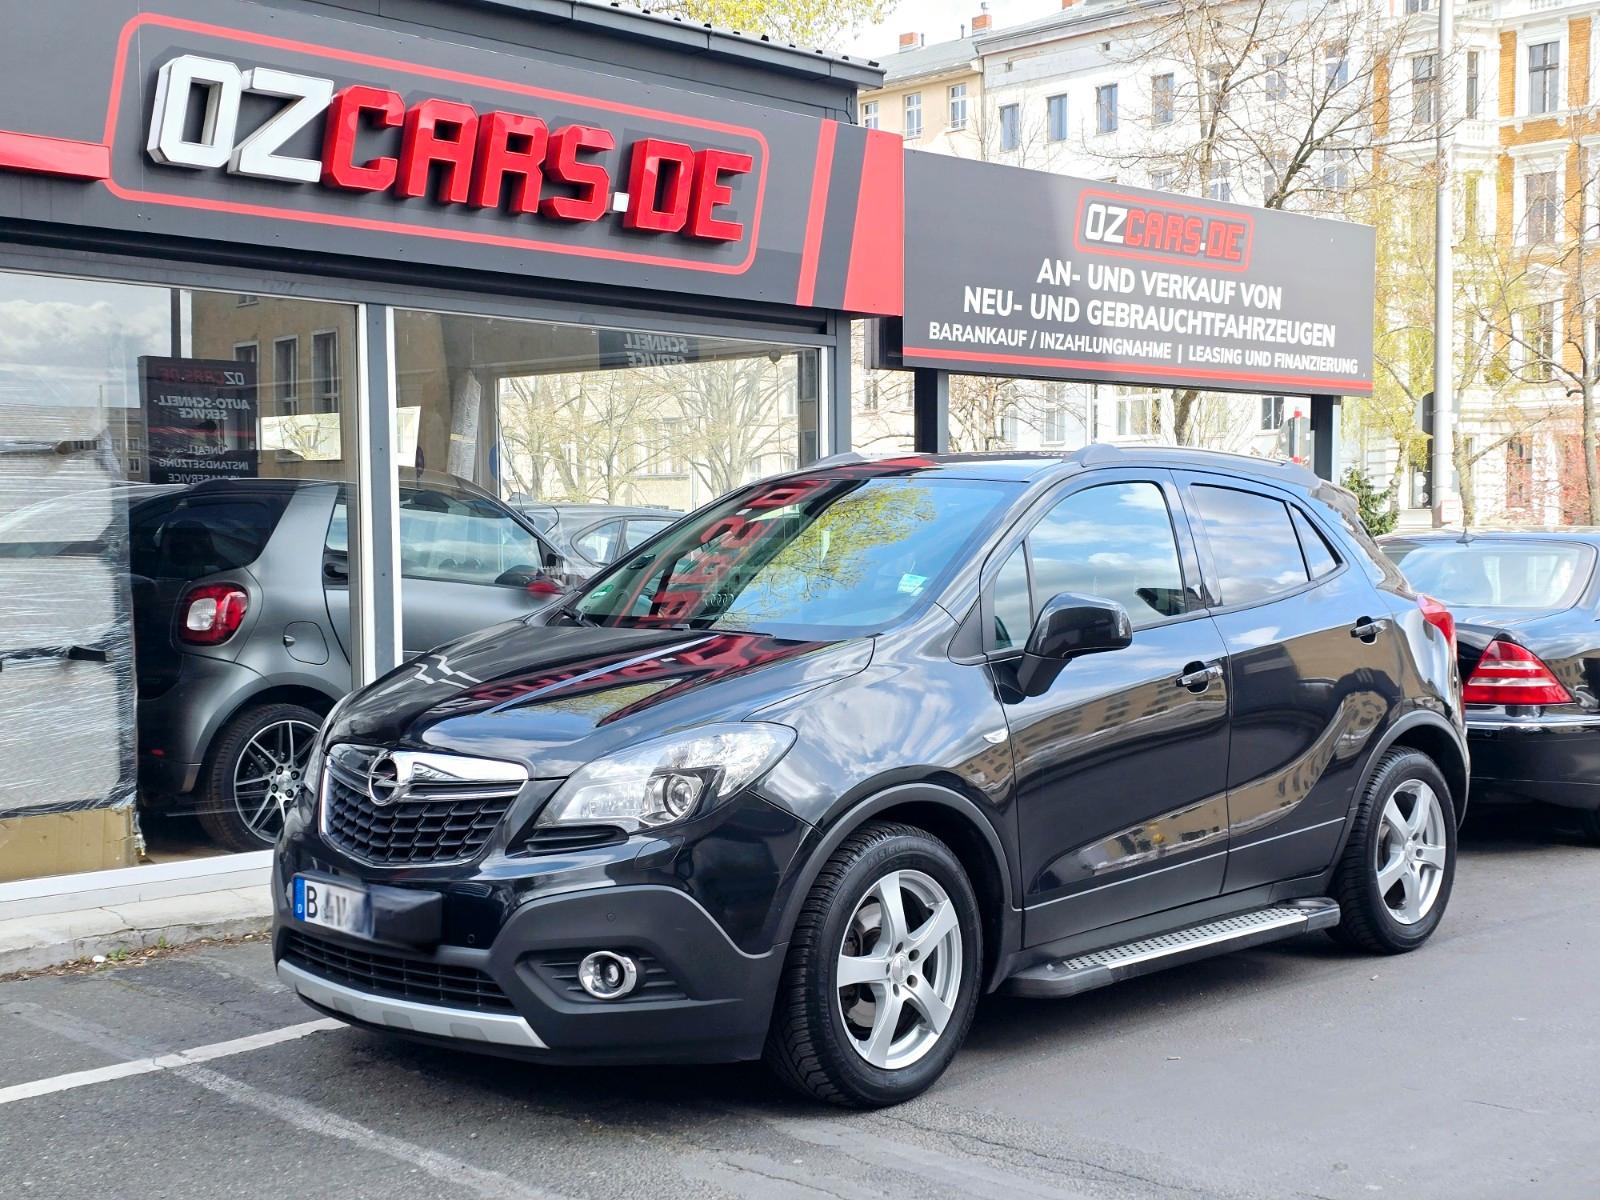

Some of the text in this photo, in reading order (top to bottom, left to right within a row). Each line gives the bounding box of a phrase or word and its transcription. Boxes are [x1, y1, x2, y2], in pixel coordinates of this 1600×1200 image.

[147, 54, 753, 242] OZCARS.DE
[1085, 203, 1245, 261] OZCARS.DE
[1036, 258, 1282, 310] AN- UND VERKAUF VON
[963, 285, 1336, 348] NEU- UND GEBRAUCHTFAHRZEUGEN
[929, 321, 1028, 347] BARANKAUF
[1040, 332, 1172, 360] INZAHLUNGNAHME
[1188, 345, 1242, 366] LEASING
[1245, 350, 1272, 368] UND
[1274, 352, 1359, 375] FINANZIERUNG
